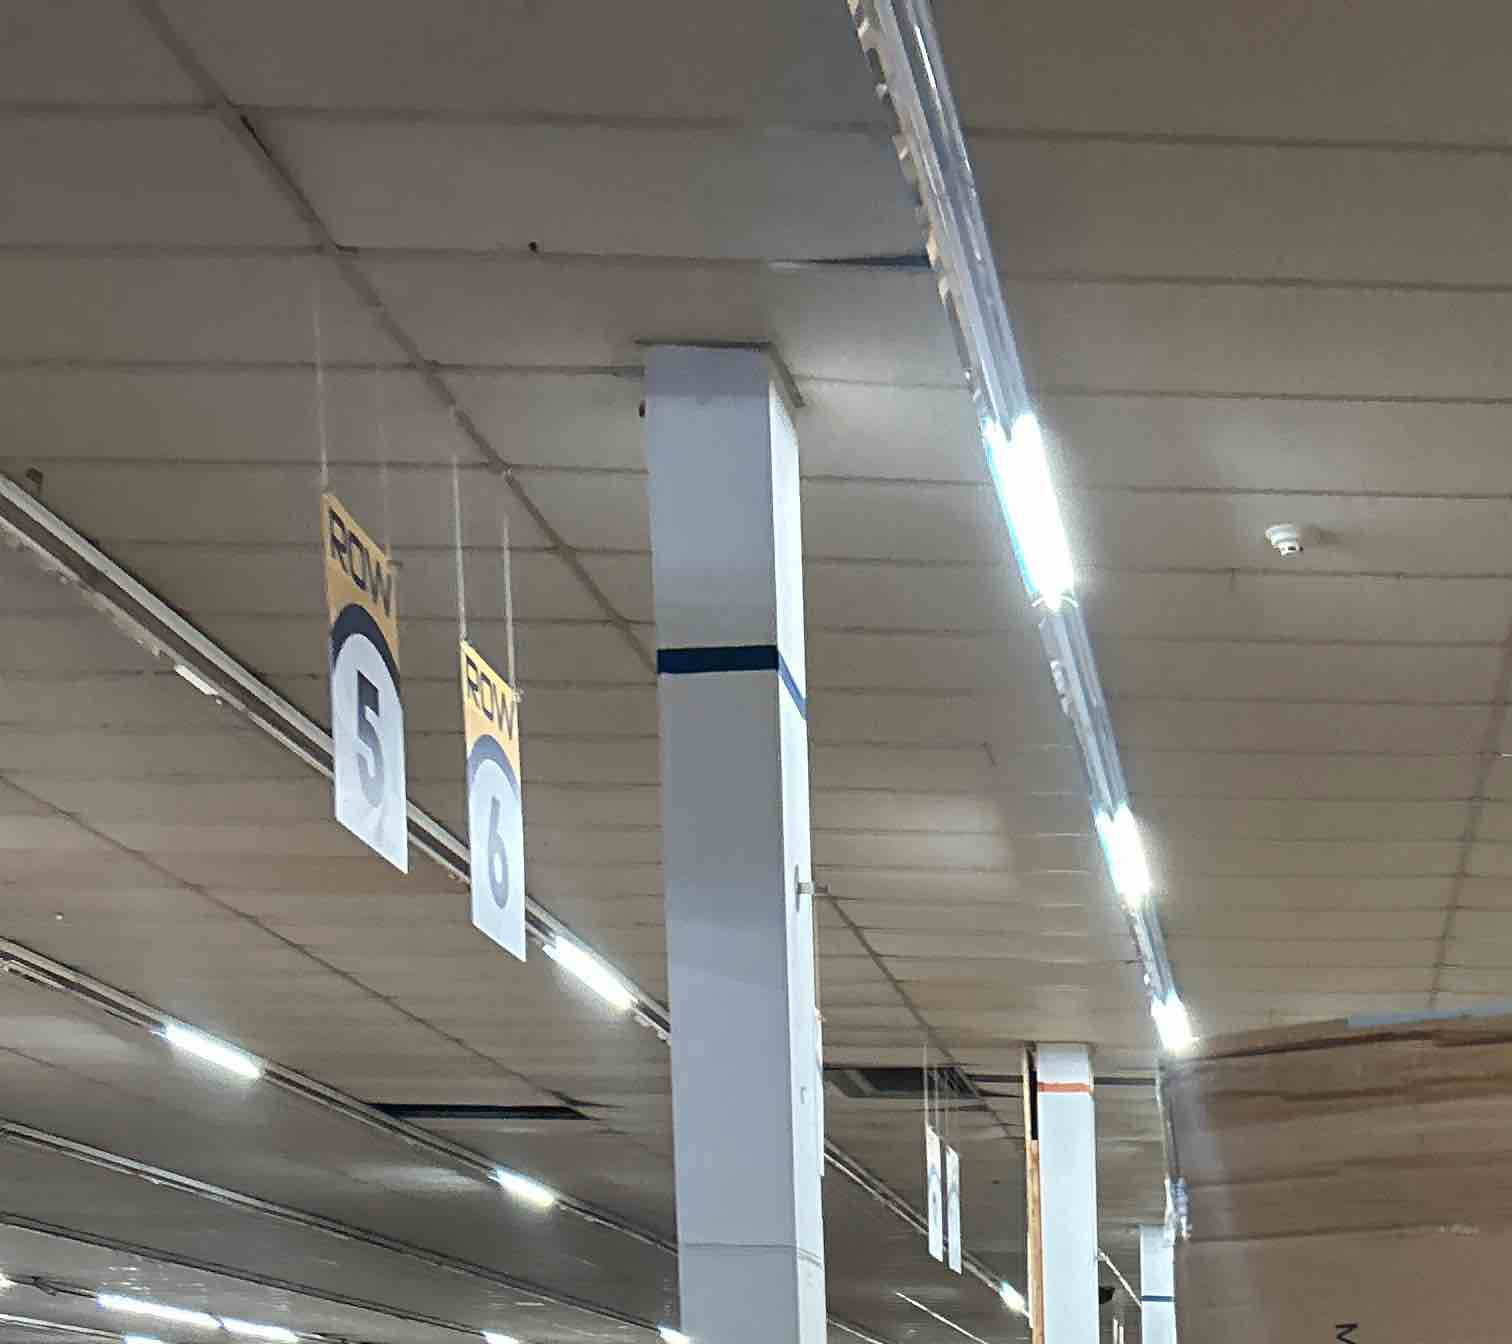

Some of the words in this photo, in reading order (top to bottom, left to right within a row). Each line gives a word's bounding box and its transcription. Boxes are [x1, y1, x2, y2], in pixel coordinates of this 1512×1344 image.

[328, 510, 393, 617] ROW
[355, 670, 386, 808] 5
[465, 655, 516, 741] ROW
[487, 796, 508, 908] 6
